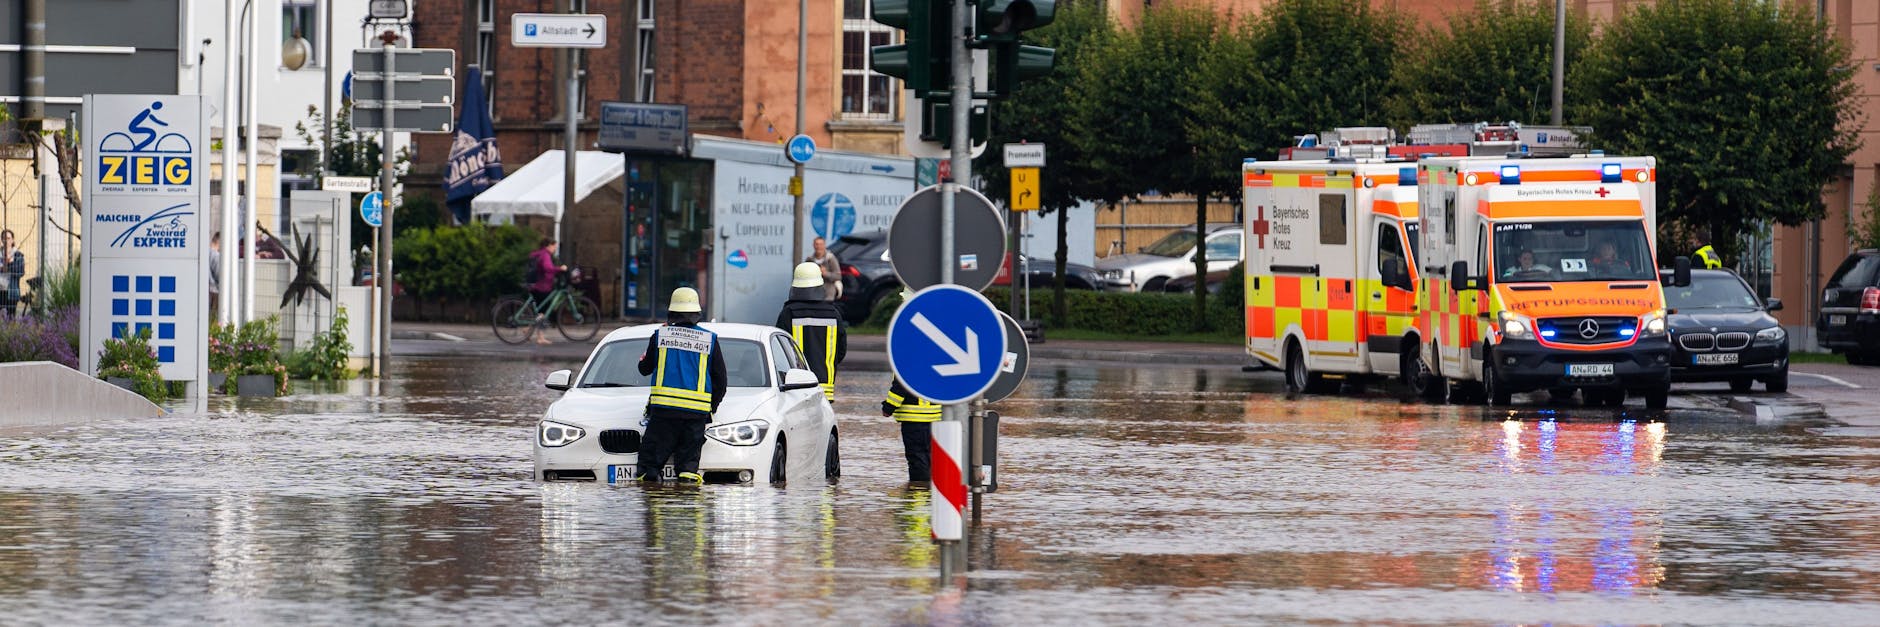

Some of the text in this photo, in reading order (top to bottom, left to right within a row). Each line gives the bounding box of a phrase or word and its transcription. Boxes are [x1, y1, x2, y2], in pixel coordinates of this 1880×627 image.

[542, 26, 578, 35] Altstadt
[101, 157, 190, 185] ZEG
[327, 179, 368, 188] Gartenstraße
[96, 214, 141, 222] MAICHER
[1273, 205, 1309, 220] Bayerisches
[146, 228, 186, 236] Zweirad
[1273, 221, 1291, 235] Rotes
[134, 237, 186, 247] EXPERTE
[1273, 237, 1291, 250] Kreuz
[1510, 297, 1655, 311] RETTUNGSDIENST
[667, 327, 704, 336] FEUERWEHR
[660, 338, 709, 352] Ansbach 40/1
[616, 467, 632, 479] AN
